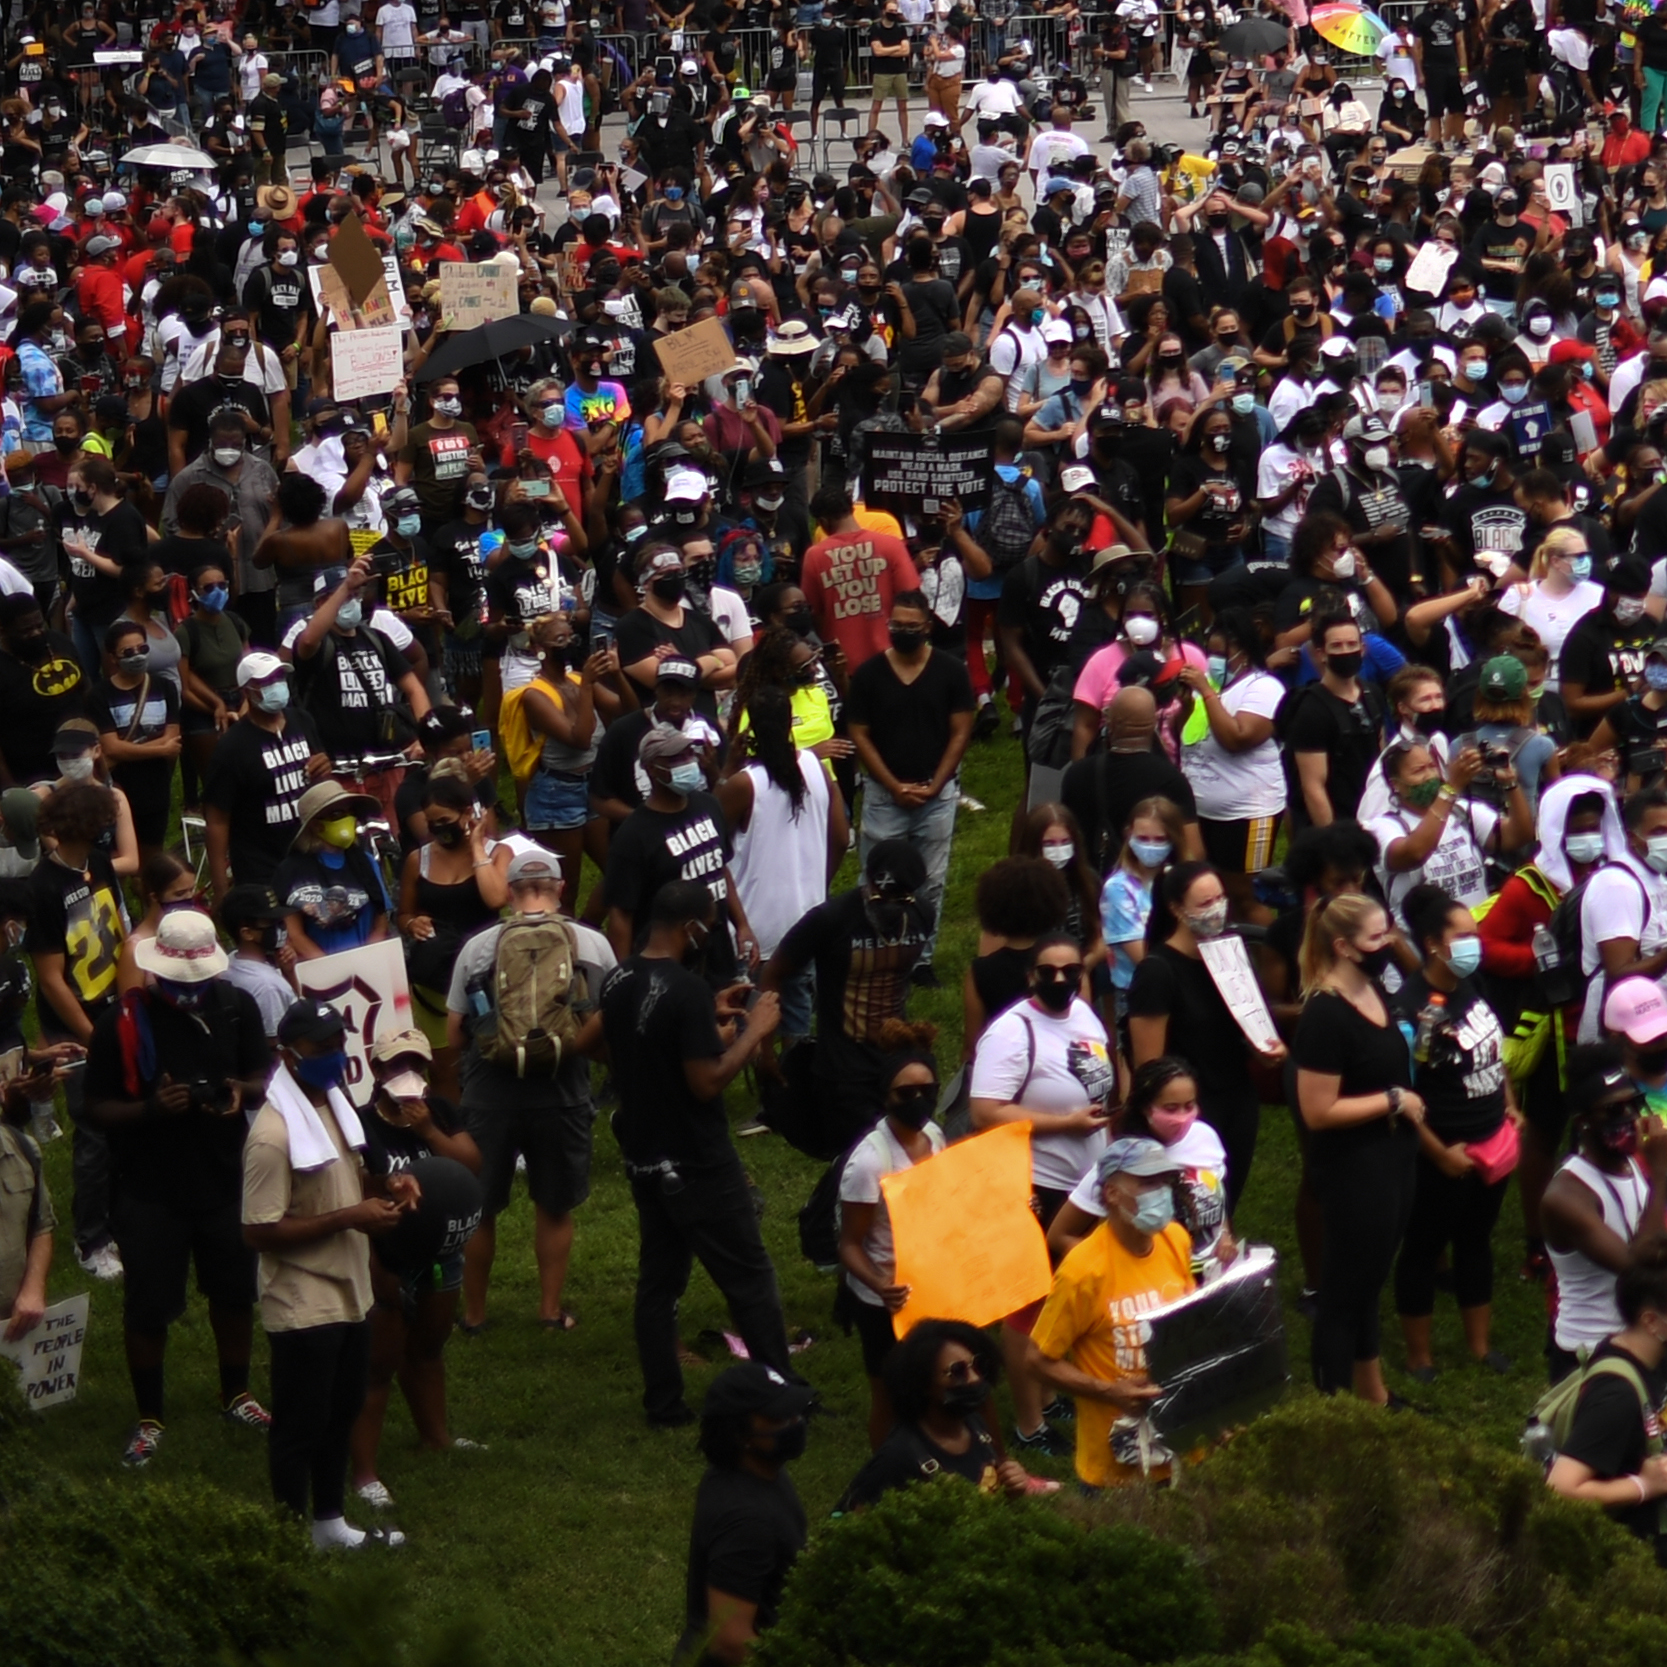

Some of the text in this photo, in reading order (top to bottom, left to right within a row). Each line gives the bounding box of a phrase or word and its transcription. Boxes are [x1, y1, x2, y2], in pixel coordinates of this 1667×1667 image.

[1332, 24, 1378, 46] MATTER
[901, 461, 963, 472] WEAR A MASK
[915, 452, 946, 462] SOCIAL
[948, 448, 988, 462] DISTANCE
[873, 478, 986, 496] PROTECT THE VOTE
[930, 470, 975, 483] SANITIZER
[825, 541, 872, 566] YOU
[820, 557, 888, 589] LET UP
[834, 576, 877, 601] YOU
[833, 594, 881, 620] LOSE
[262, 739, 312, 770] BLACK
[665, 818, 720, 857] BLACK
[681, 847, 723, 881] LIVES
[45, 1313, 78, 1332] THE
[32, 1327, 85, 1356] PEOPLE
[46, 1354, 66, 1375] IN
[26, 1372, 77, 1400] POWER
